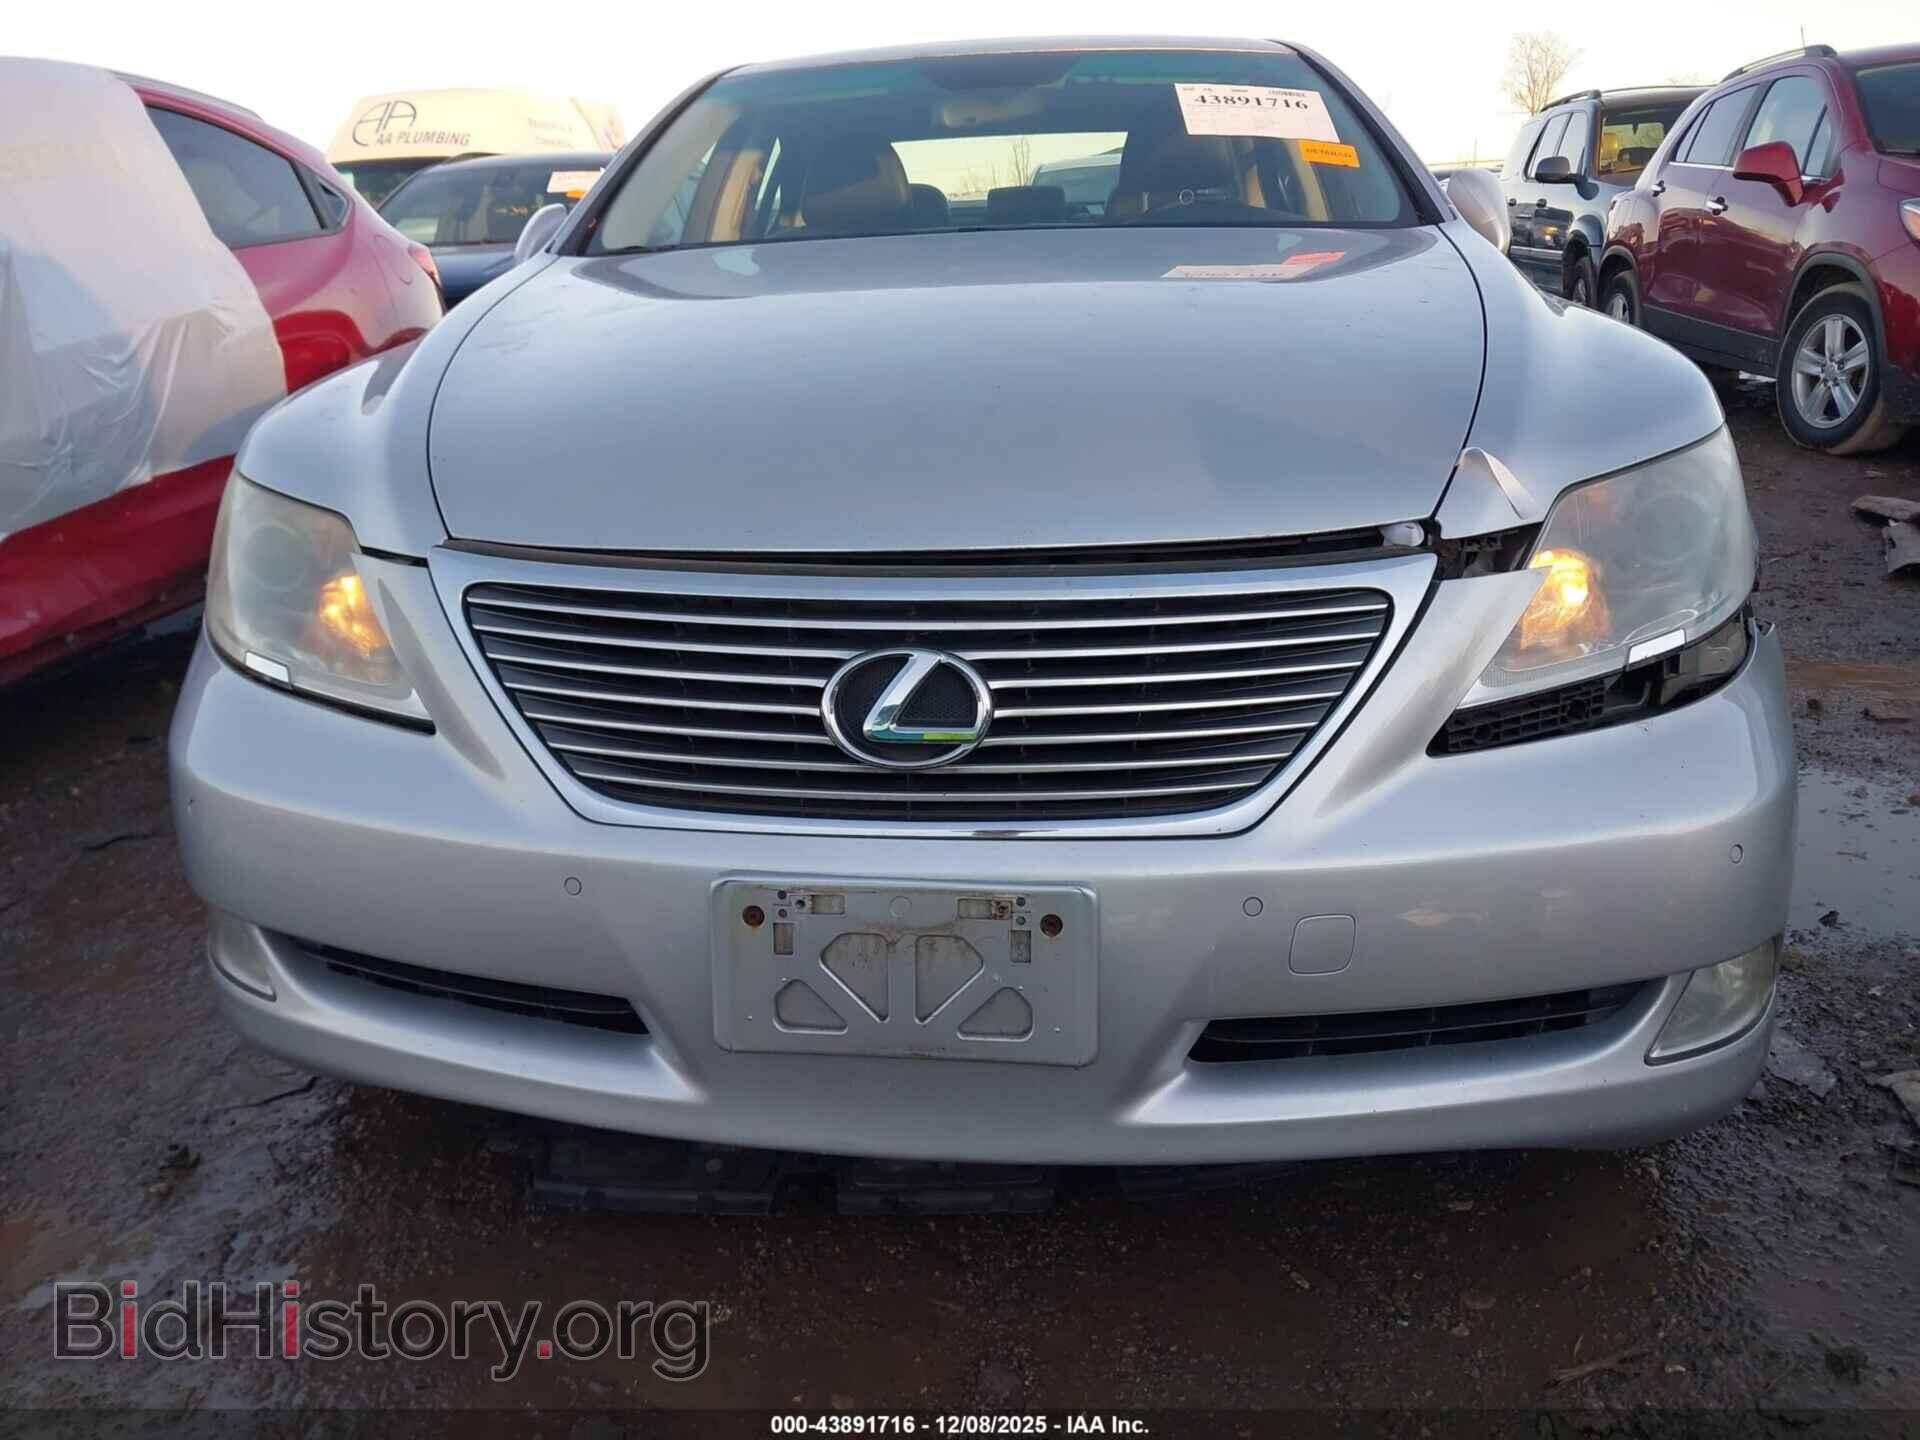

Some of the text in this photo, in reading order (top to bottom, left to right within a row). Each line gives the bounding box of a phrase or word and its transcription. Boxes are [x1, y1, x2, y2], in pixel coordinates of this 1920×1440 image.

[1194, 94, 1309, 110] 43891716
[376, 131, 471, 146] AA PLUMBING
